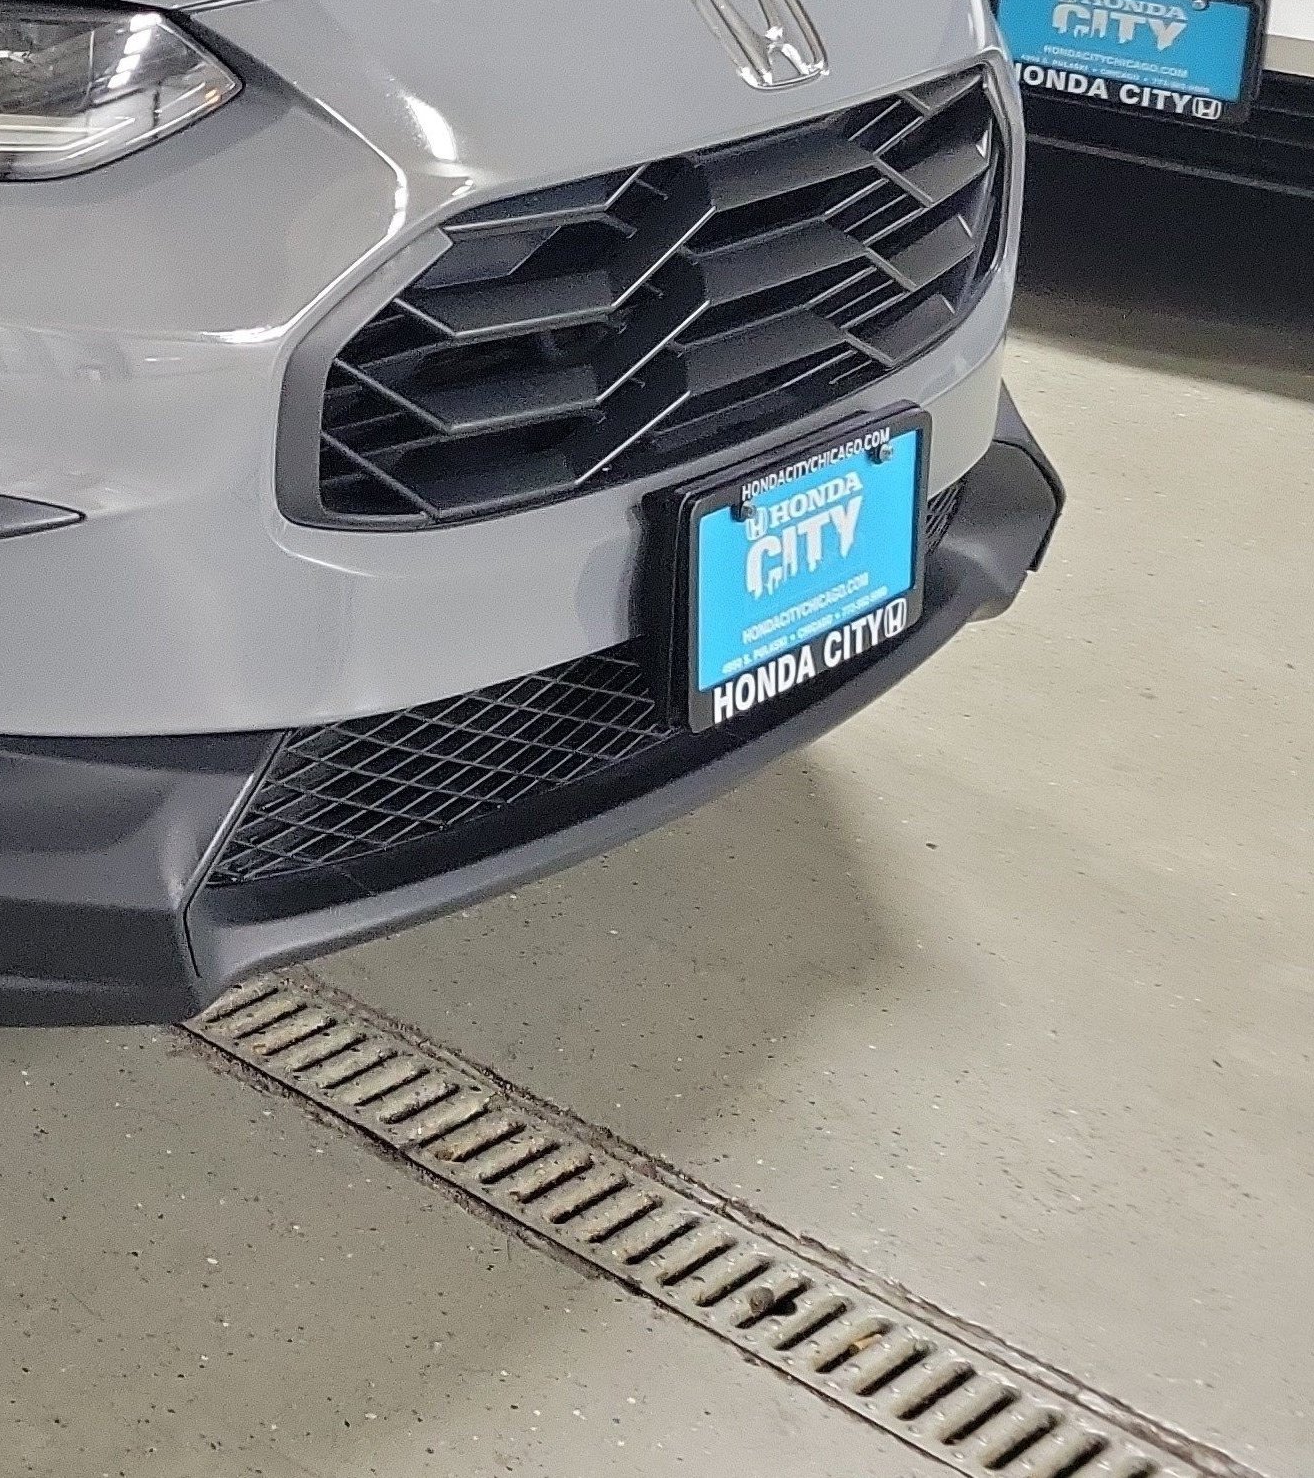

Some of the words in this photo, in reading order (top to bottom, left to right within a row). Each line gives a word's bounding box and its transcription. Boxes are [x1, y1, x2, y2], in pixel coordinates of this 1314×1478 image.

[1052, 4, 1188, 52] CITY
[1119, 84, 1193, 115] CITY
[741, 427, 891, 501] HONDACITYCHICAGO.COM
[770, 470, 864, 529] HONDA
[745, 495, 864, 600] CITY
[713, 648, 815, 725] HONDA
[825, 608, 885, 669] CITY
